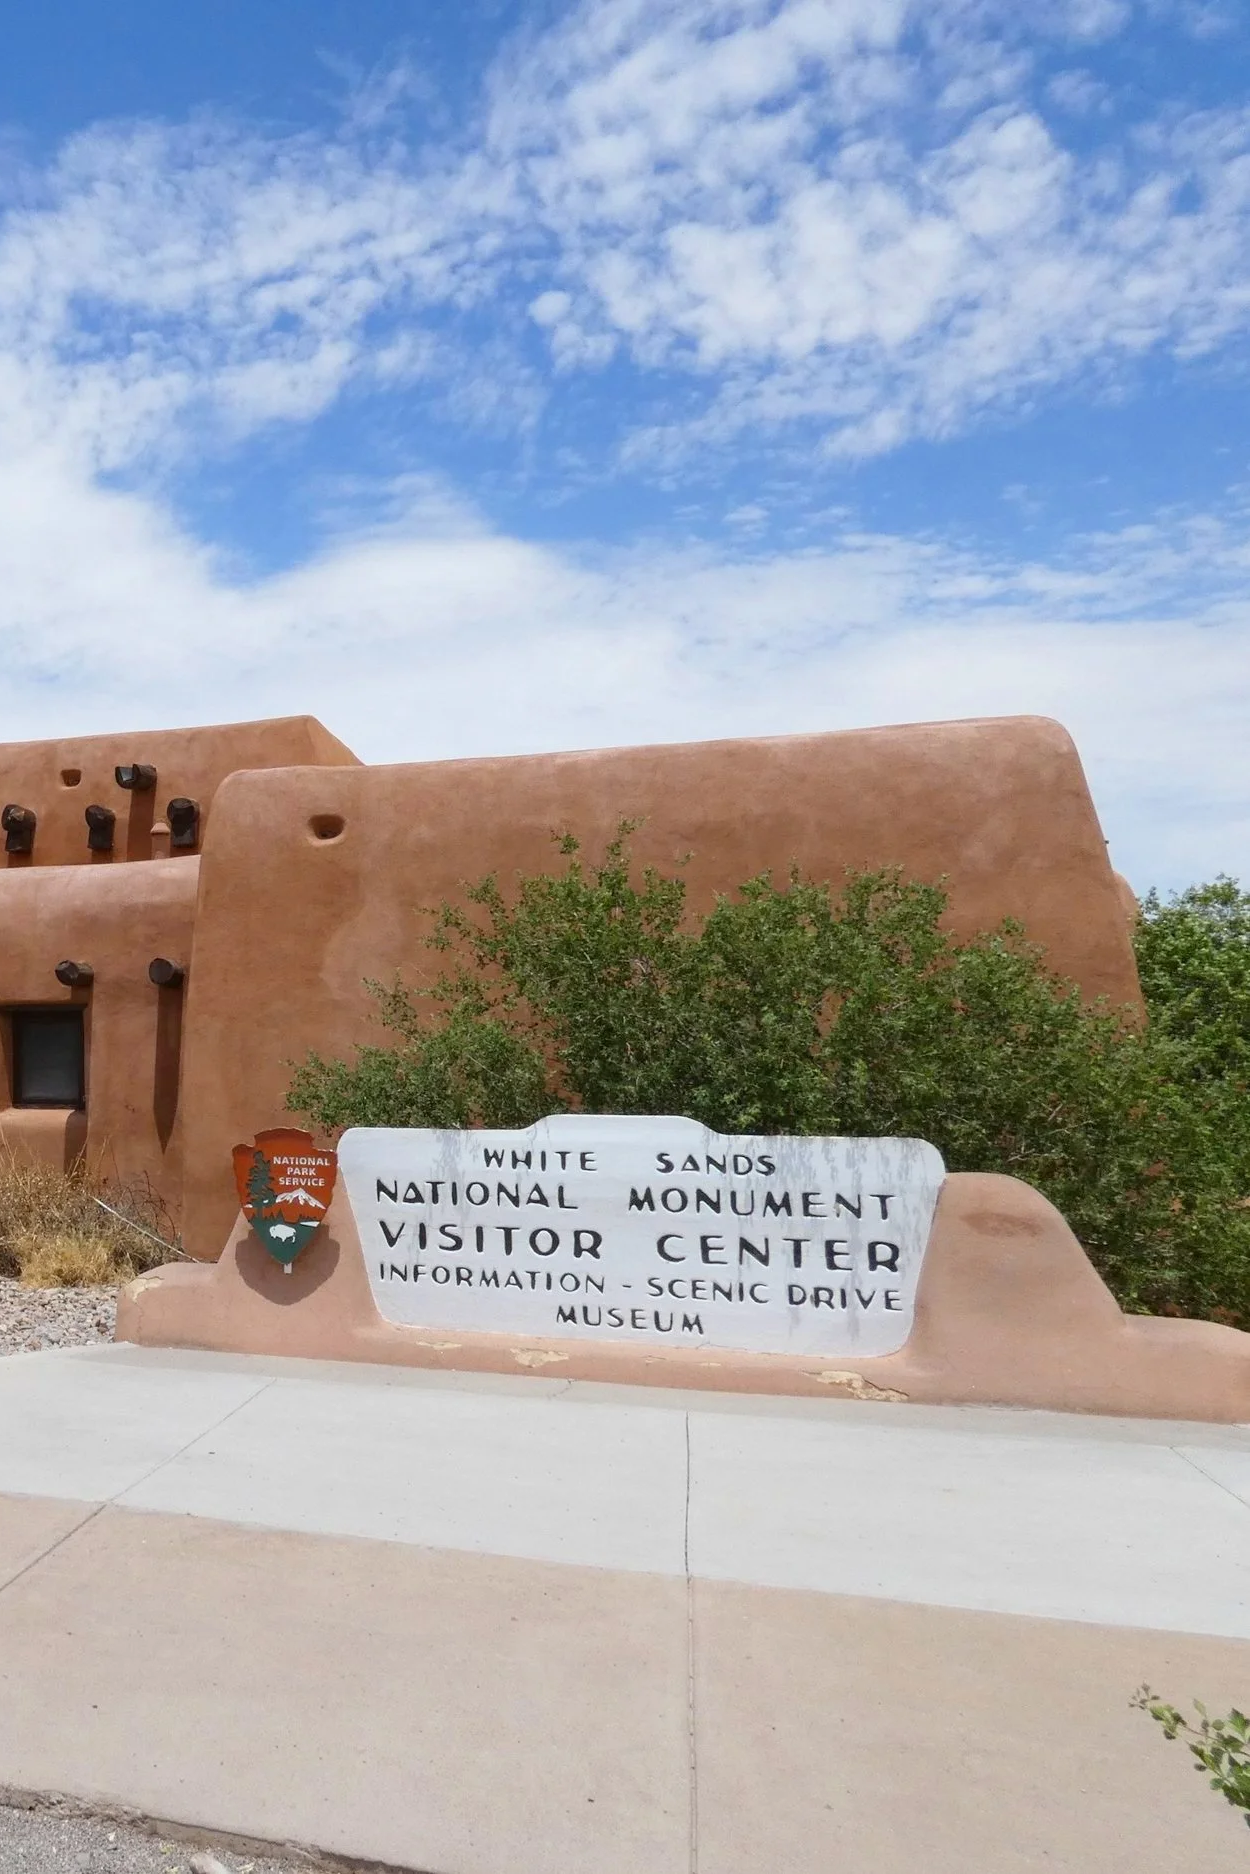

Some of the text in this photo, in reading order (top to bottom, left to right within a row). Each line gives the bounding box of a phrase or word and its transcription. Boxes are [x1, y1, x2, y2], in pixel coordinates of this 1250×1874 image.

[273, 1156, 330, 1166] NATIONAL
[287, 1167, 316, 1176] PARK
[483, 1148, 777, 1177] WHITE SANDS
[278, 1176, 326, 1187] SERVICE
[376, 1178, 896, 1221] NATIONAL MONUMENT
[379, 1220, 901, 1273] VISITOR CENTER
[379, 1263, 605, 1294] INFORMATION
[647, 1277, 769, 1304] SCENIC
[787, 1285, 903, 1311] DRIVE
[556, 1305, 704, 1335] MUSEUM
